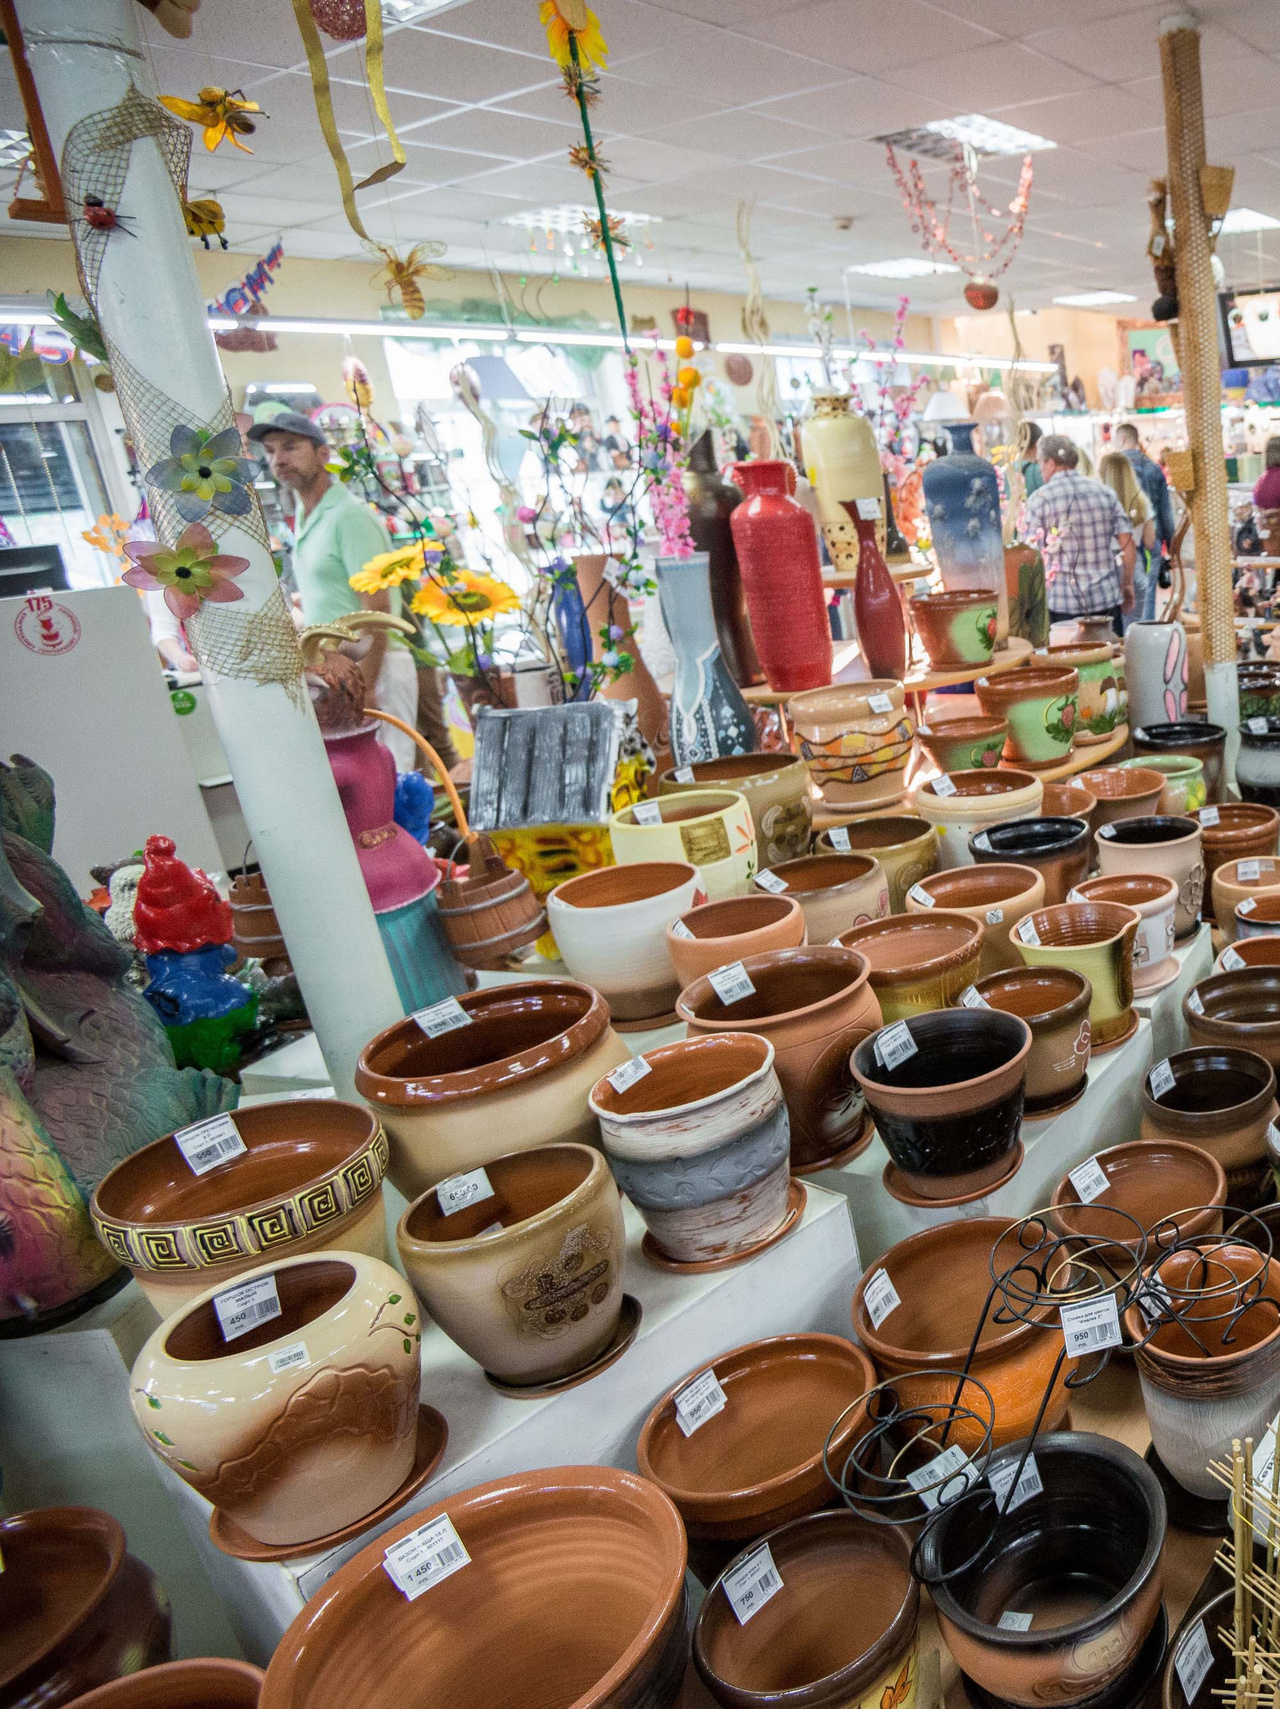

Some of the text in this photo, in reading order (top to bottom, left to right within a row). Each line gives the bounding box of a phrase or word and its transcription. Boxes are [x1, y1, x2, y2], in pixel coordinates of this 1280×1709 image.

[24, 595, 53, 612] 175
[196, 1149, 212, 1161] 950
[220, 1281, 270, 1304] ГОРШОК ОСТРОВ
[230, 1312, 247, 1325] 450
[1073, 1331, 1089, 1342] 950
[689, 1405, 702, 1418] 950
[397, 1546, 418, 1562] ВАЗОН
[406, 1552, 420, 1563] Сорт
[407, 1561, 432, 1582] 1 450
[740, 1590, 754, 1606] 750
